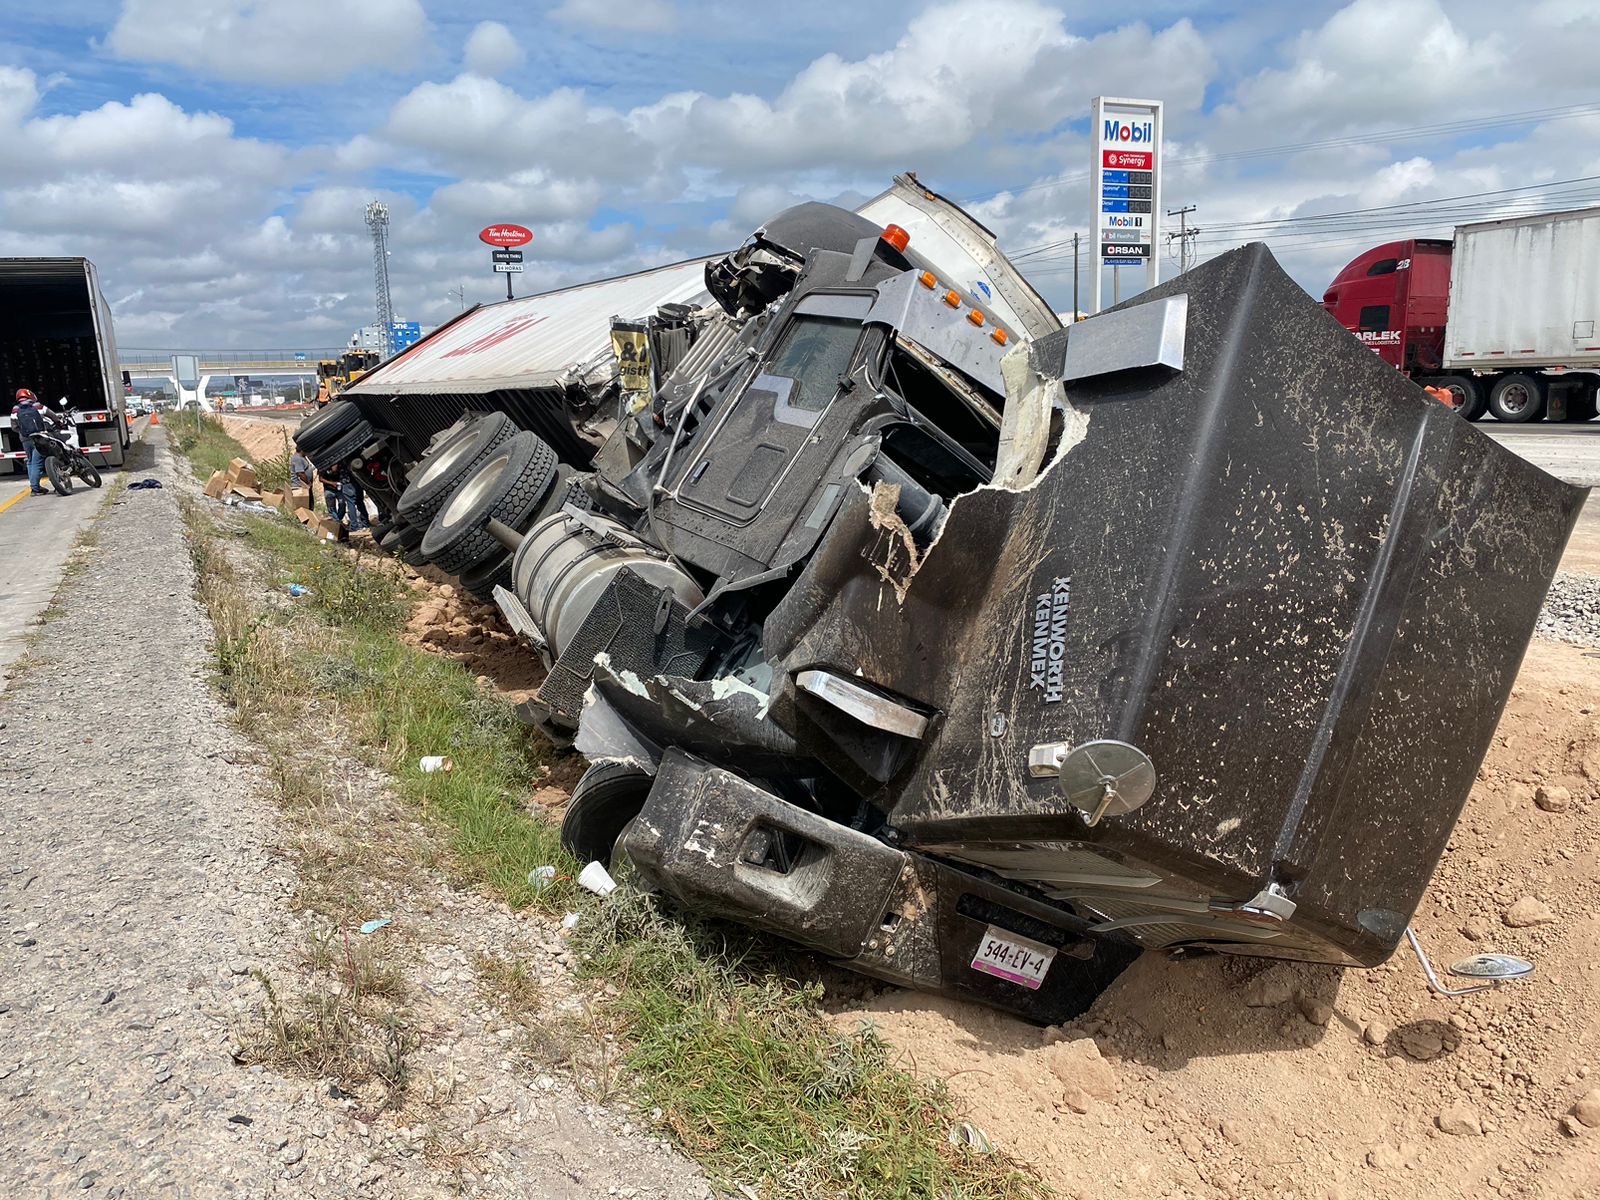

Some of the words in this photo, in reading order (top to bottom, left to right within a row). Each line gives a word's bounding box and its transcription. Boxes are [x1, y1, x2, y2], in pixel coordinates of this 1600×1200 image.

[1104, 120, 1152, 143] Mobil
[1119, 155, 1146, 167] Synergy
[1109, 216, 1133, 227] Mobil
[488, 228, 500, 237] Tim
[501, 228, 526, 238] Hortons
[1107, 246, 1143, 255] ORSAN
[1352, 331, 1402, 341] ARLEK
[620, 364, 649, 376] gisti
[1030, 593, 1052, 690] KENMEX
[1046, 576, 1071, 703] KENWORTH
[984, 940, 1045, 975] 544-EV-4
